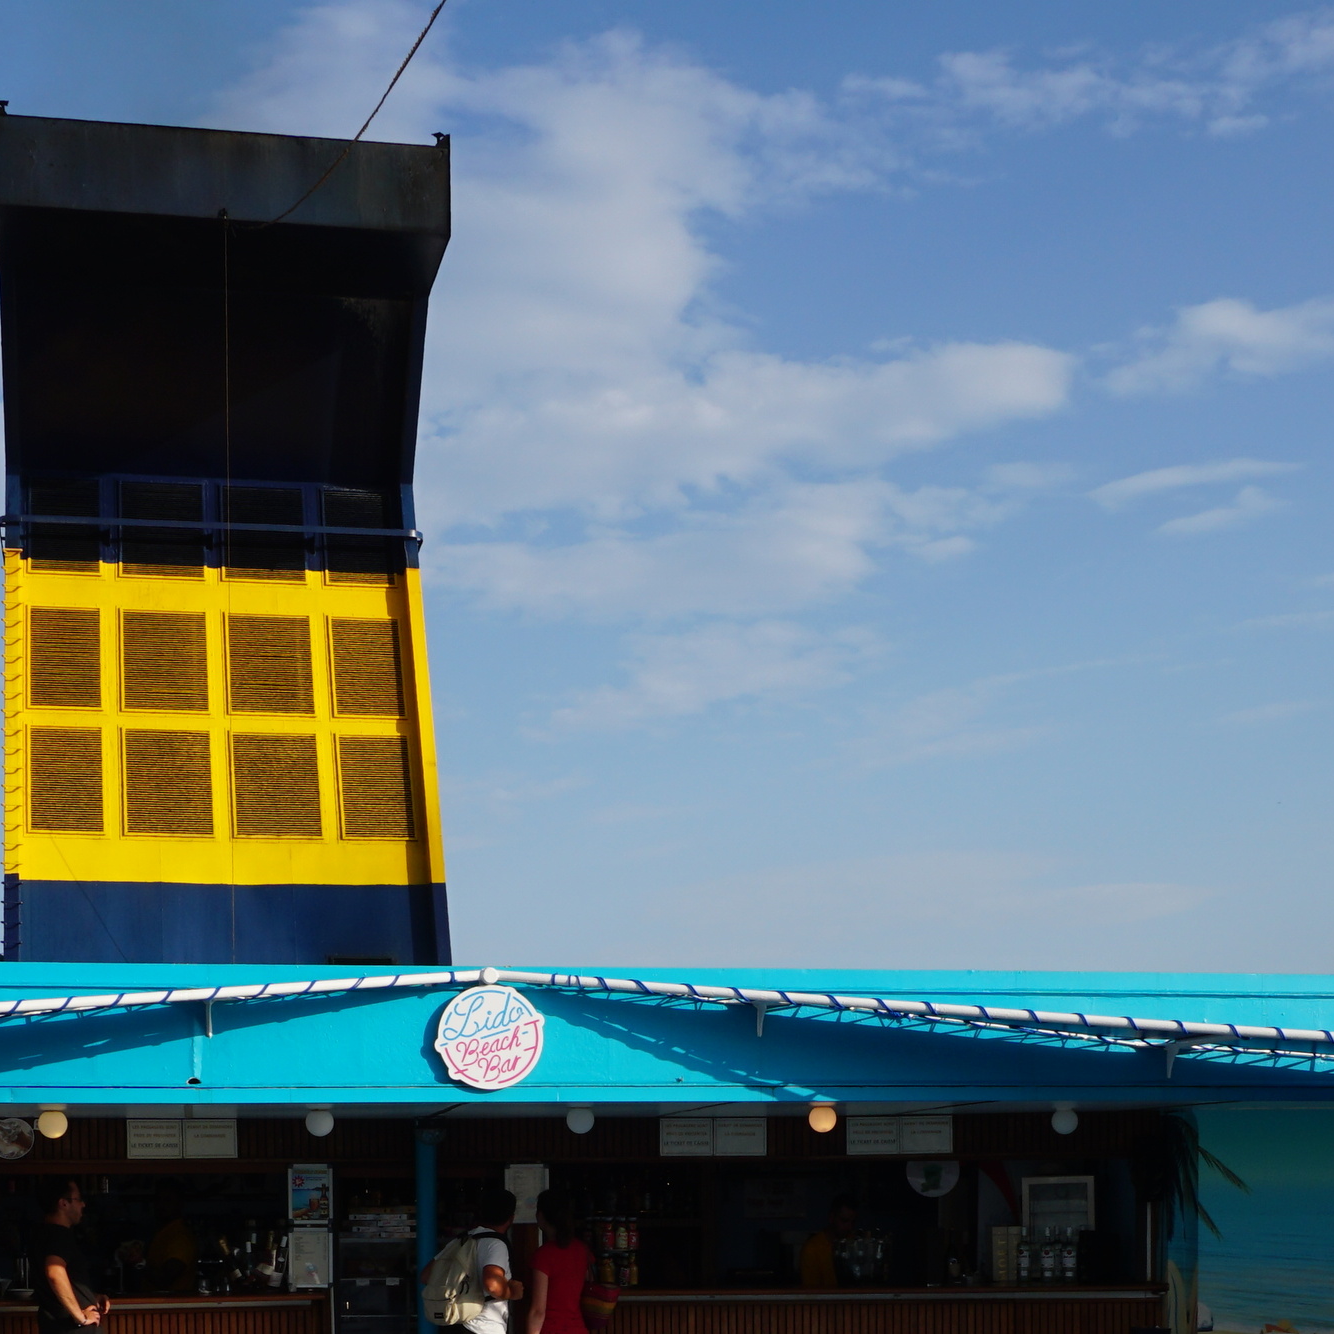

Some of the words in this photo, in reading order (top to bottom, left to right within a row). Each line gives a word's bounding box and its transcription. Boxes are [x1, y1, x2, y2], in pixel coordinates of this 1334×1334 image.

[443, 992, 524, 1040] Lido
[456, 1025, 521, 1066] Beach
[478, 1054, 521, 1082] Bar
